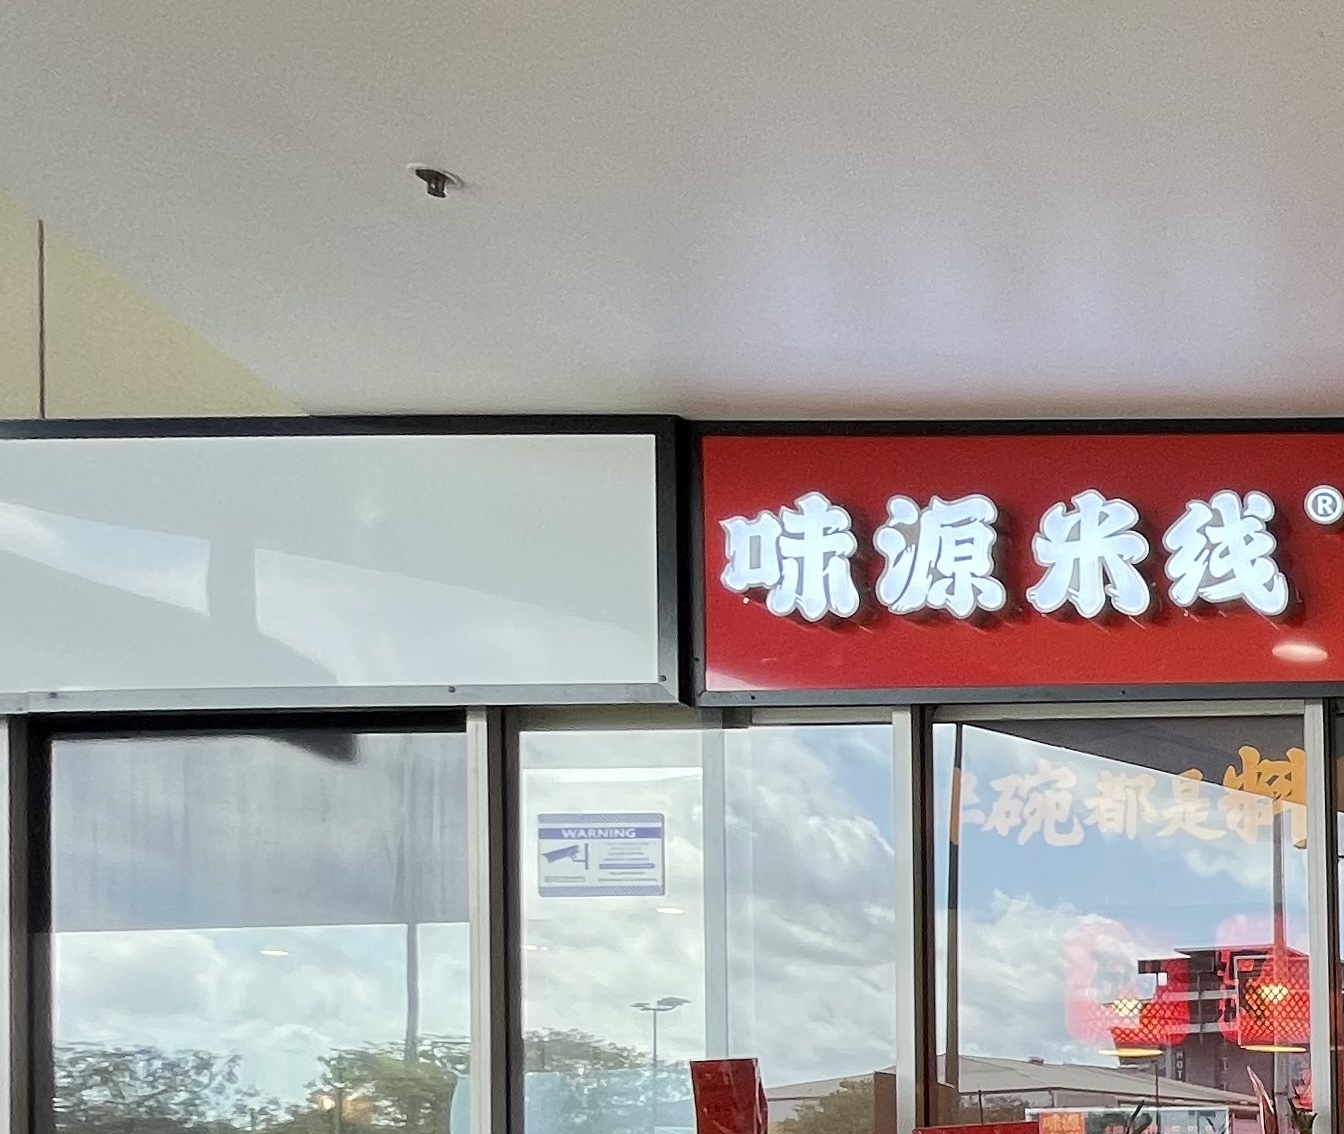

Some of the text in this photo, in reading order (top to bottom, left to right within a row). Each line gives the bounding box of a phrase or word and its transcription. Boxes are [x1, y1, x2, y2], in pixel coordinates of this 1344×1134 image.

[719, 490, 1290, 618] 味源米线
[561, 828, 636, 838] WARNING
